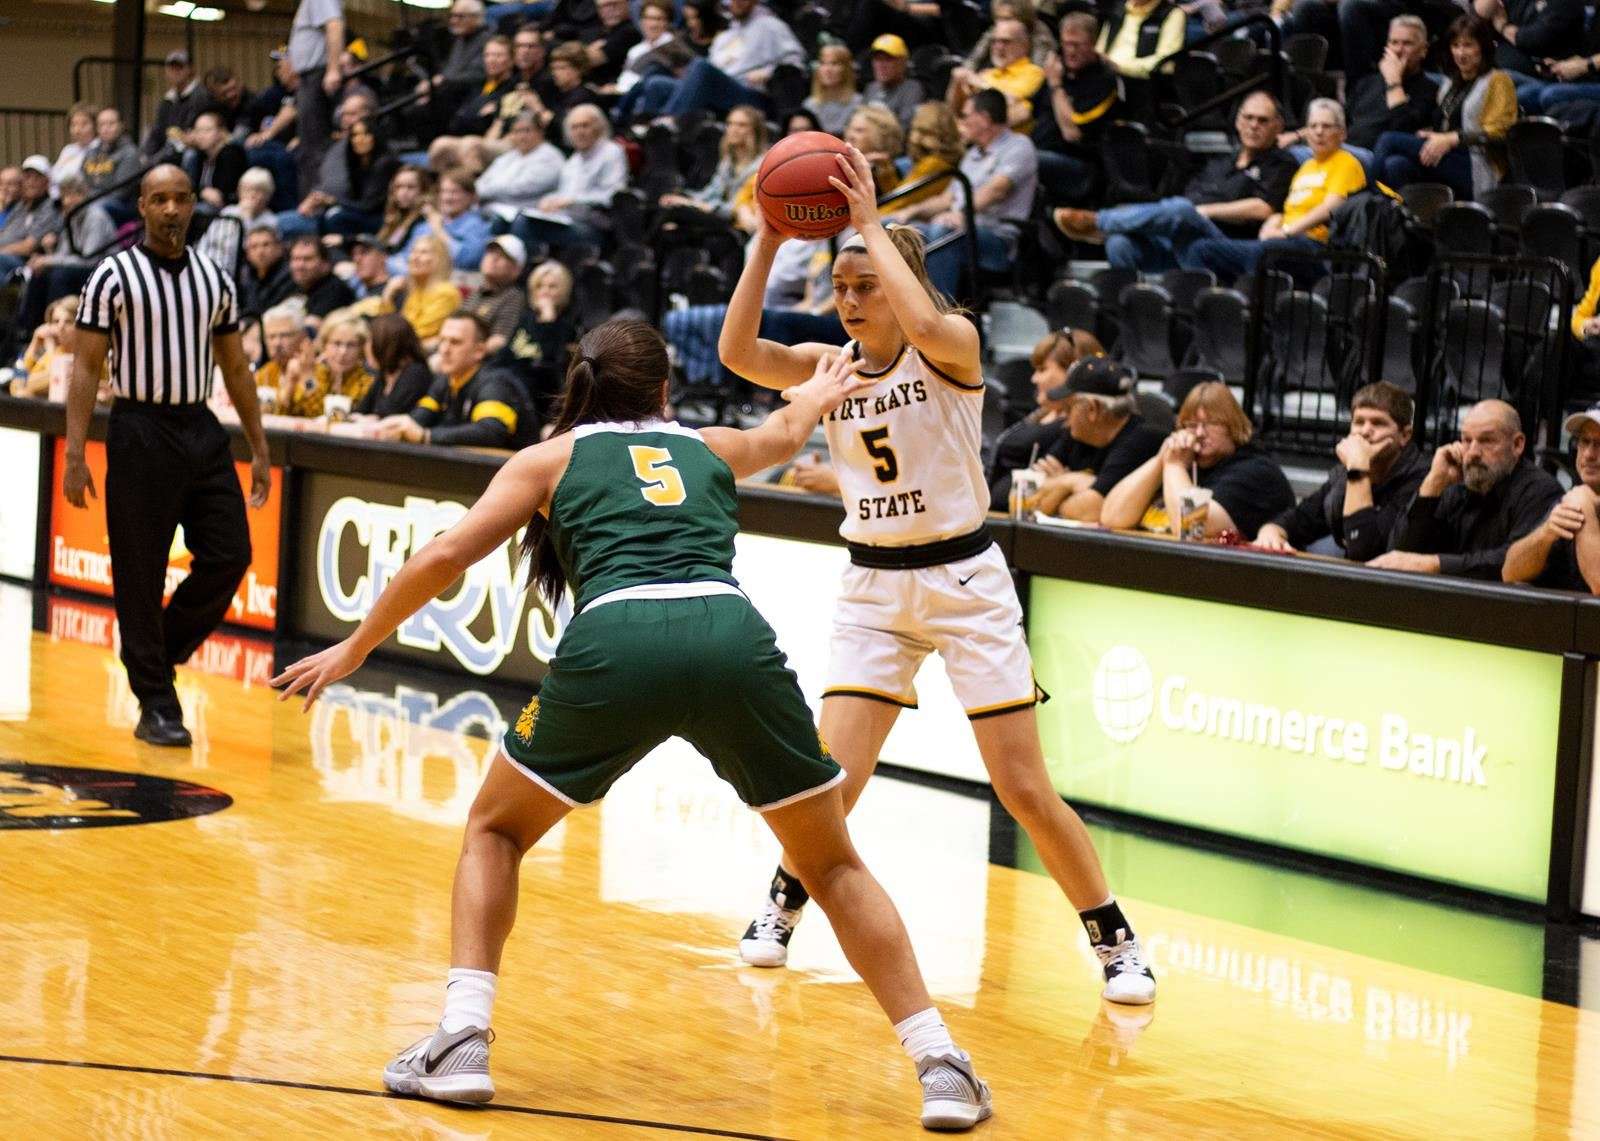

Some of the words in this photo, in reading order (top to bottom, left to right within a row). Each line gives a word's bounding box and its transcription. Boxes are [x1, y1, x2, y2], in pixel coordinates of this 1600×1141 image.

[784, 203, 849, 222] Wilso
[628, 445, 687, 506] 5
[860, 425, 898, 483] 5
[859, 489, 926, 520] STATE
[1159, 674, 1368, 764] Commerce
[1379, 712, 1489, 787] Bank
